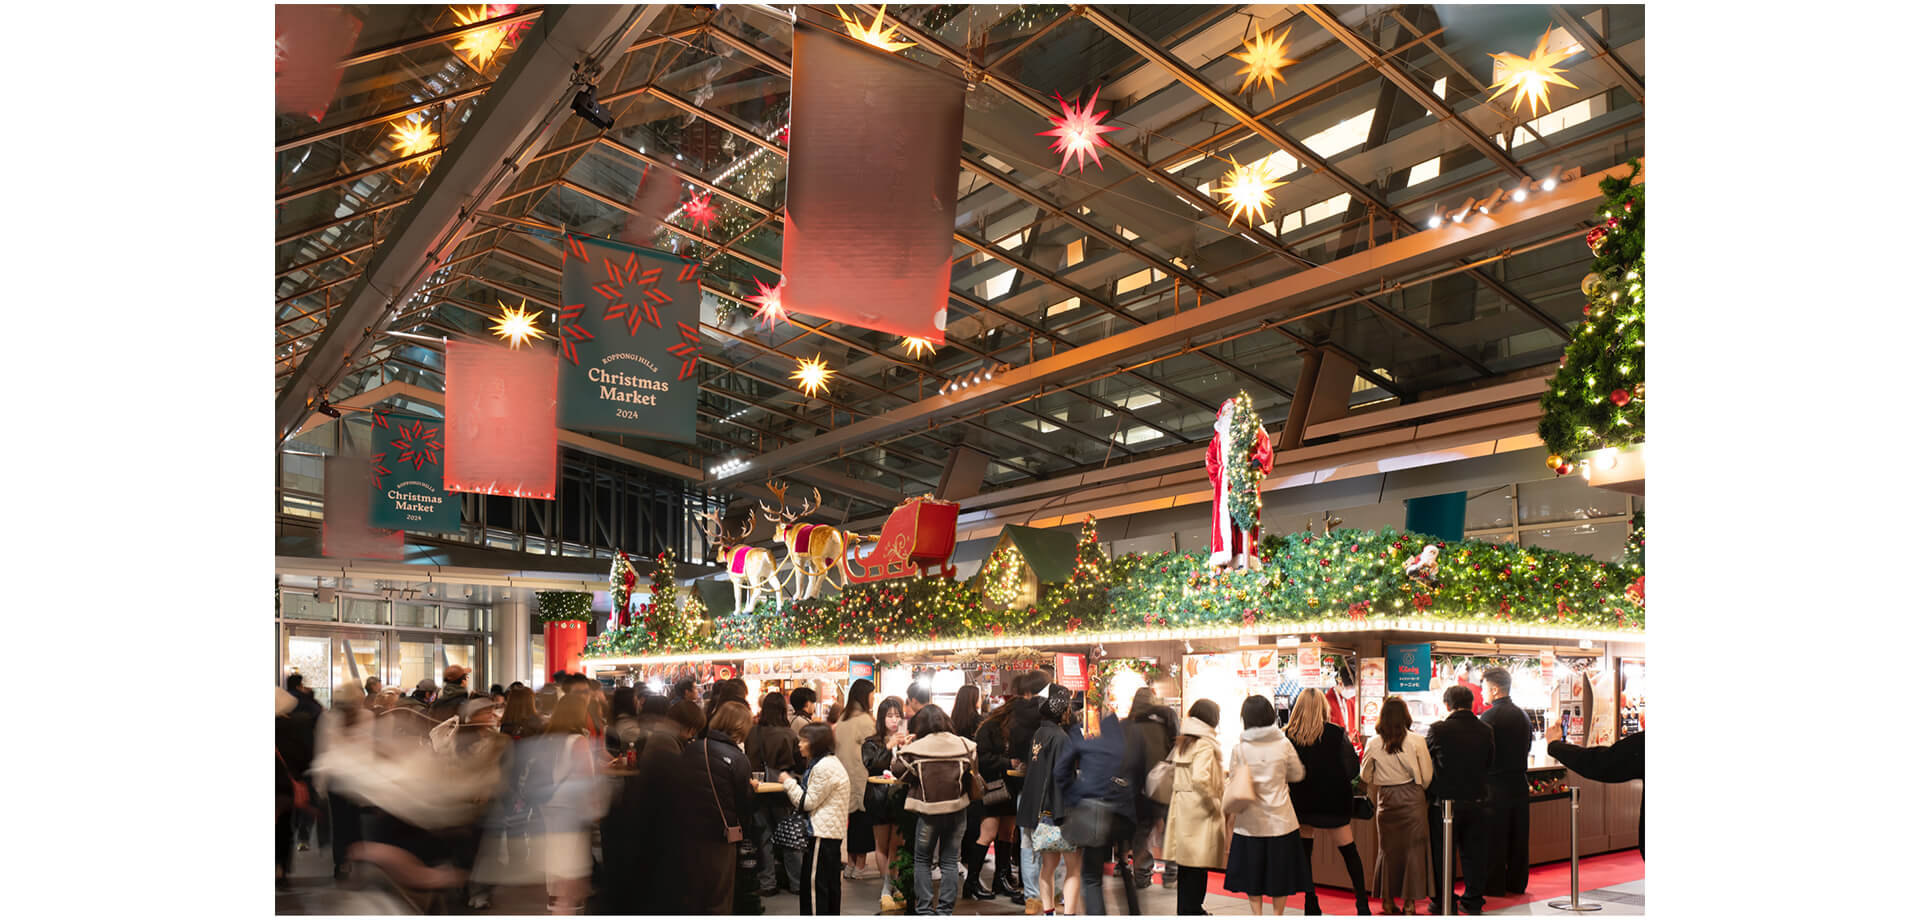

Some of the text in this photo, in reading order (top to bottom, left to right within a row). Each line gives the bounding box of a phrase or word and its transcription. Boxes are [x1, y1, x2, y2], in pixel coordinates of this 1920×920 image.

[588, 367, 669, 392] Christmas
[600, 385, 657, 406] Market
[616, 408, 639, 419] 2024
[388, 490, 442, 503] Christmas
[396, 501, 434, 512] Market
